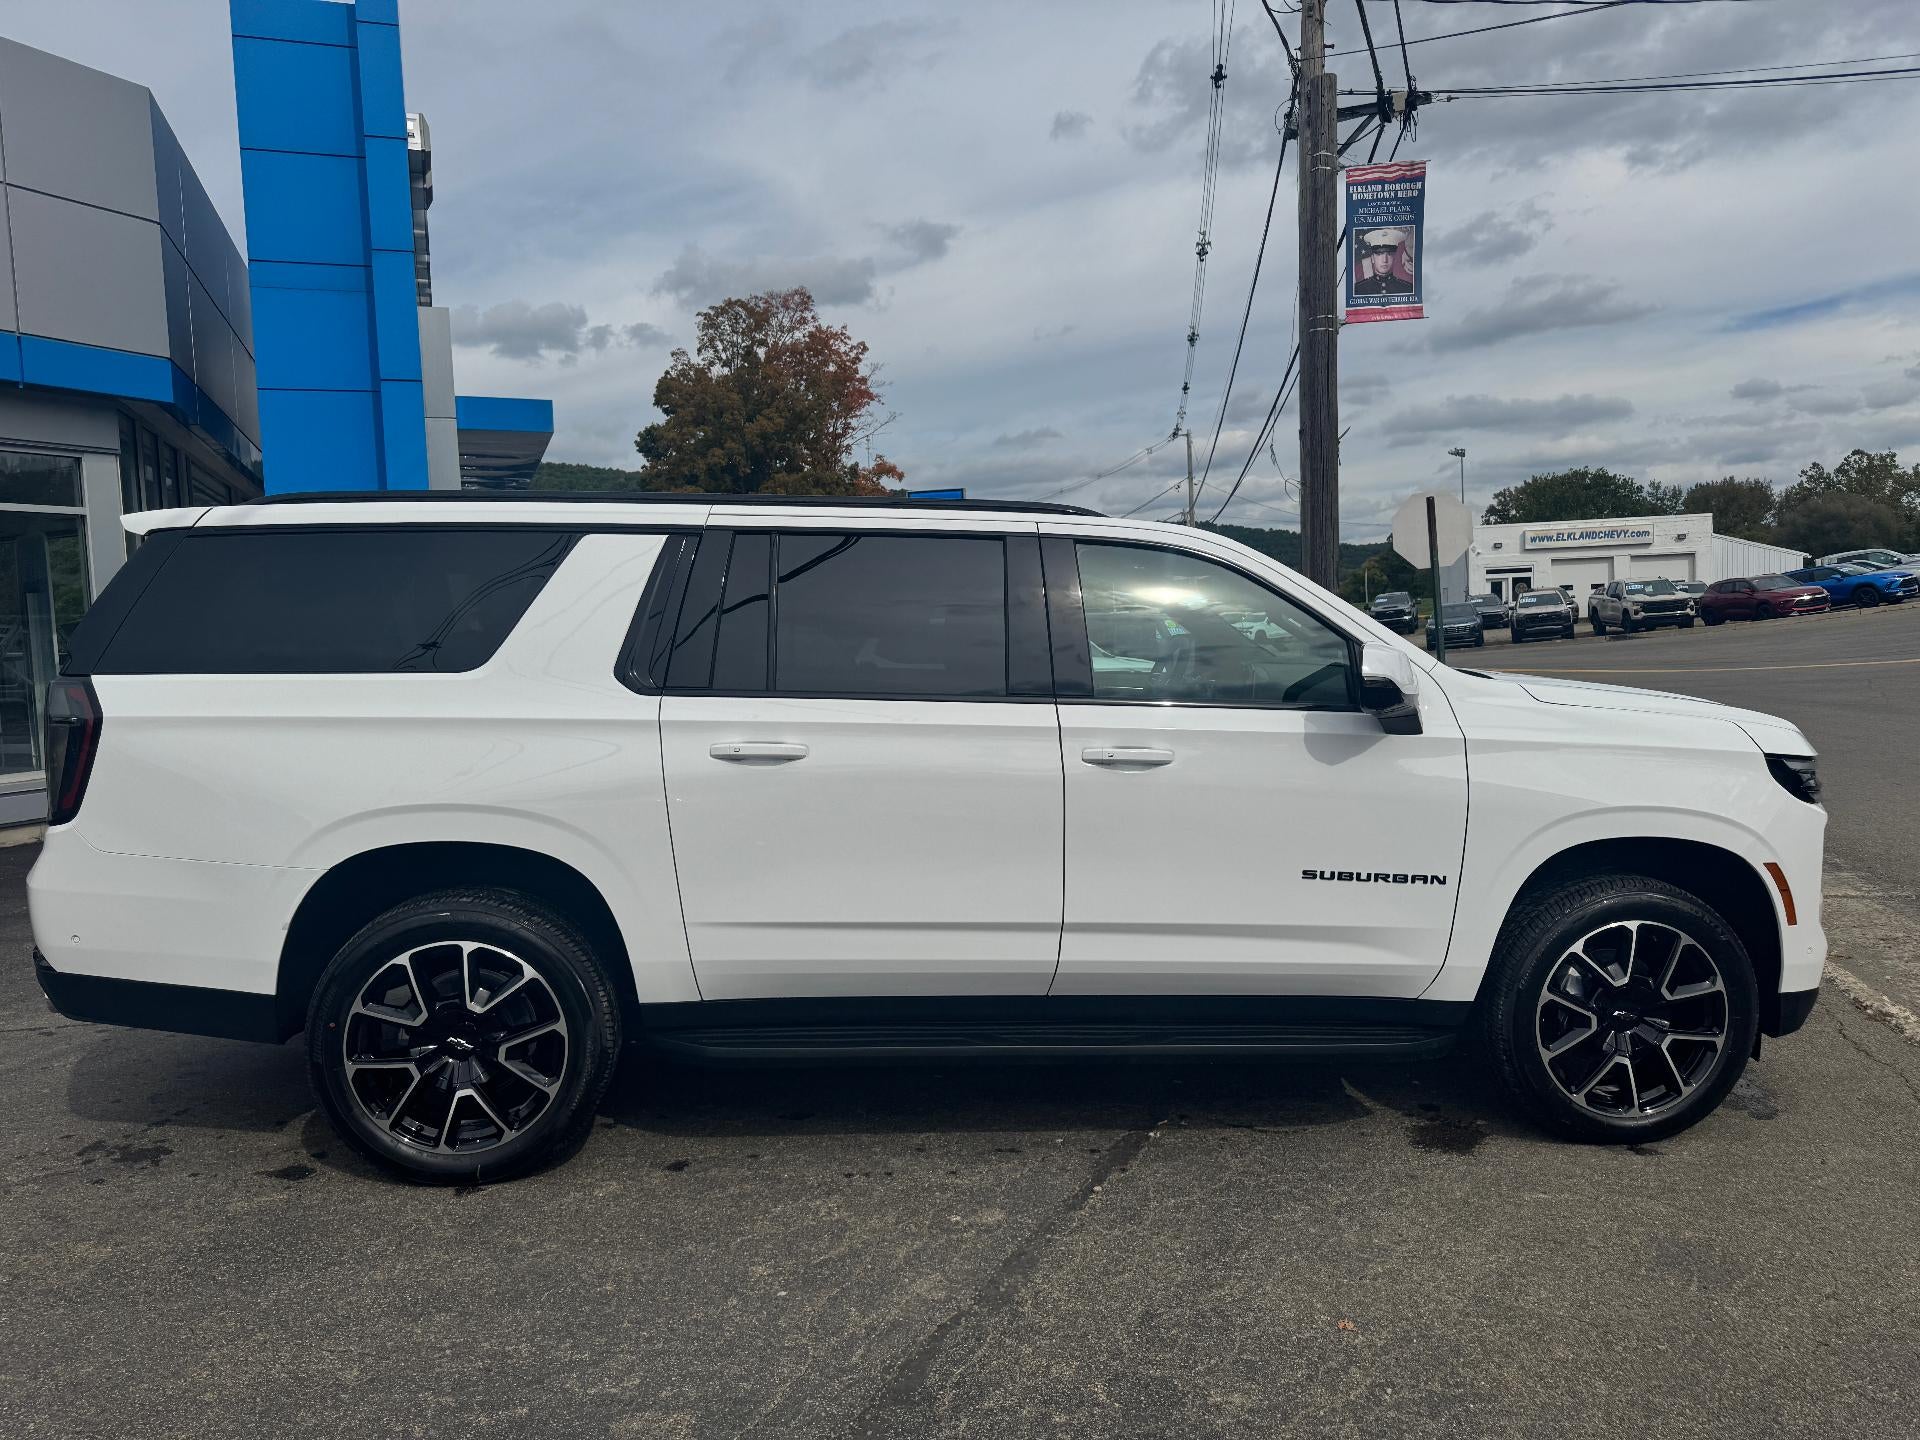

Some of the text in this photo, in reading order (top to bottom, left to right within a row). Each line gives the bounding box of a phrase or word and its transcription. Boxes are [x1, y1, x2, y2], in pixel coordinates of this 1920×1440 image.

[1349, 182, 1422, 193] ELKLAND BOROUGH
[1352, 189, 1418, 200] HOMETOWN HERO
[1389, 205, 1411, 213] PLANK
[1367, 215, 1393, 223] MARINE
[1393, 214, 1415, 222] CORPS
[1530, 529, 1650, 544] www.ELKLANDCHEVY.com
[1301, 869, 1447, 885] SUBURBAN
